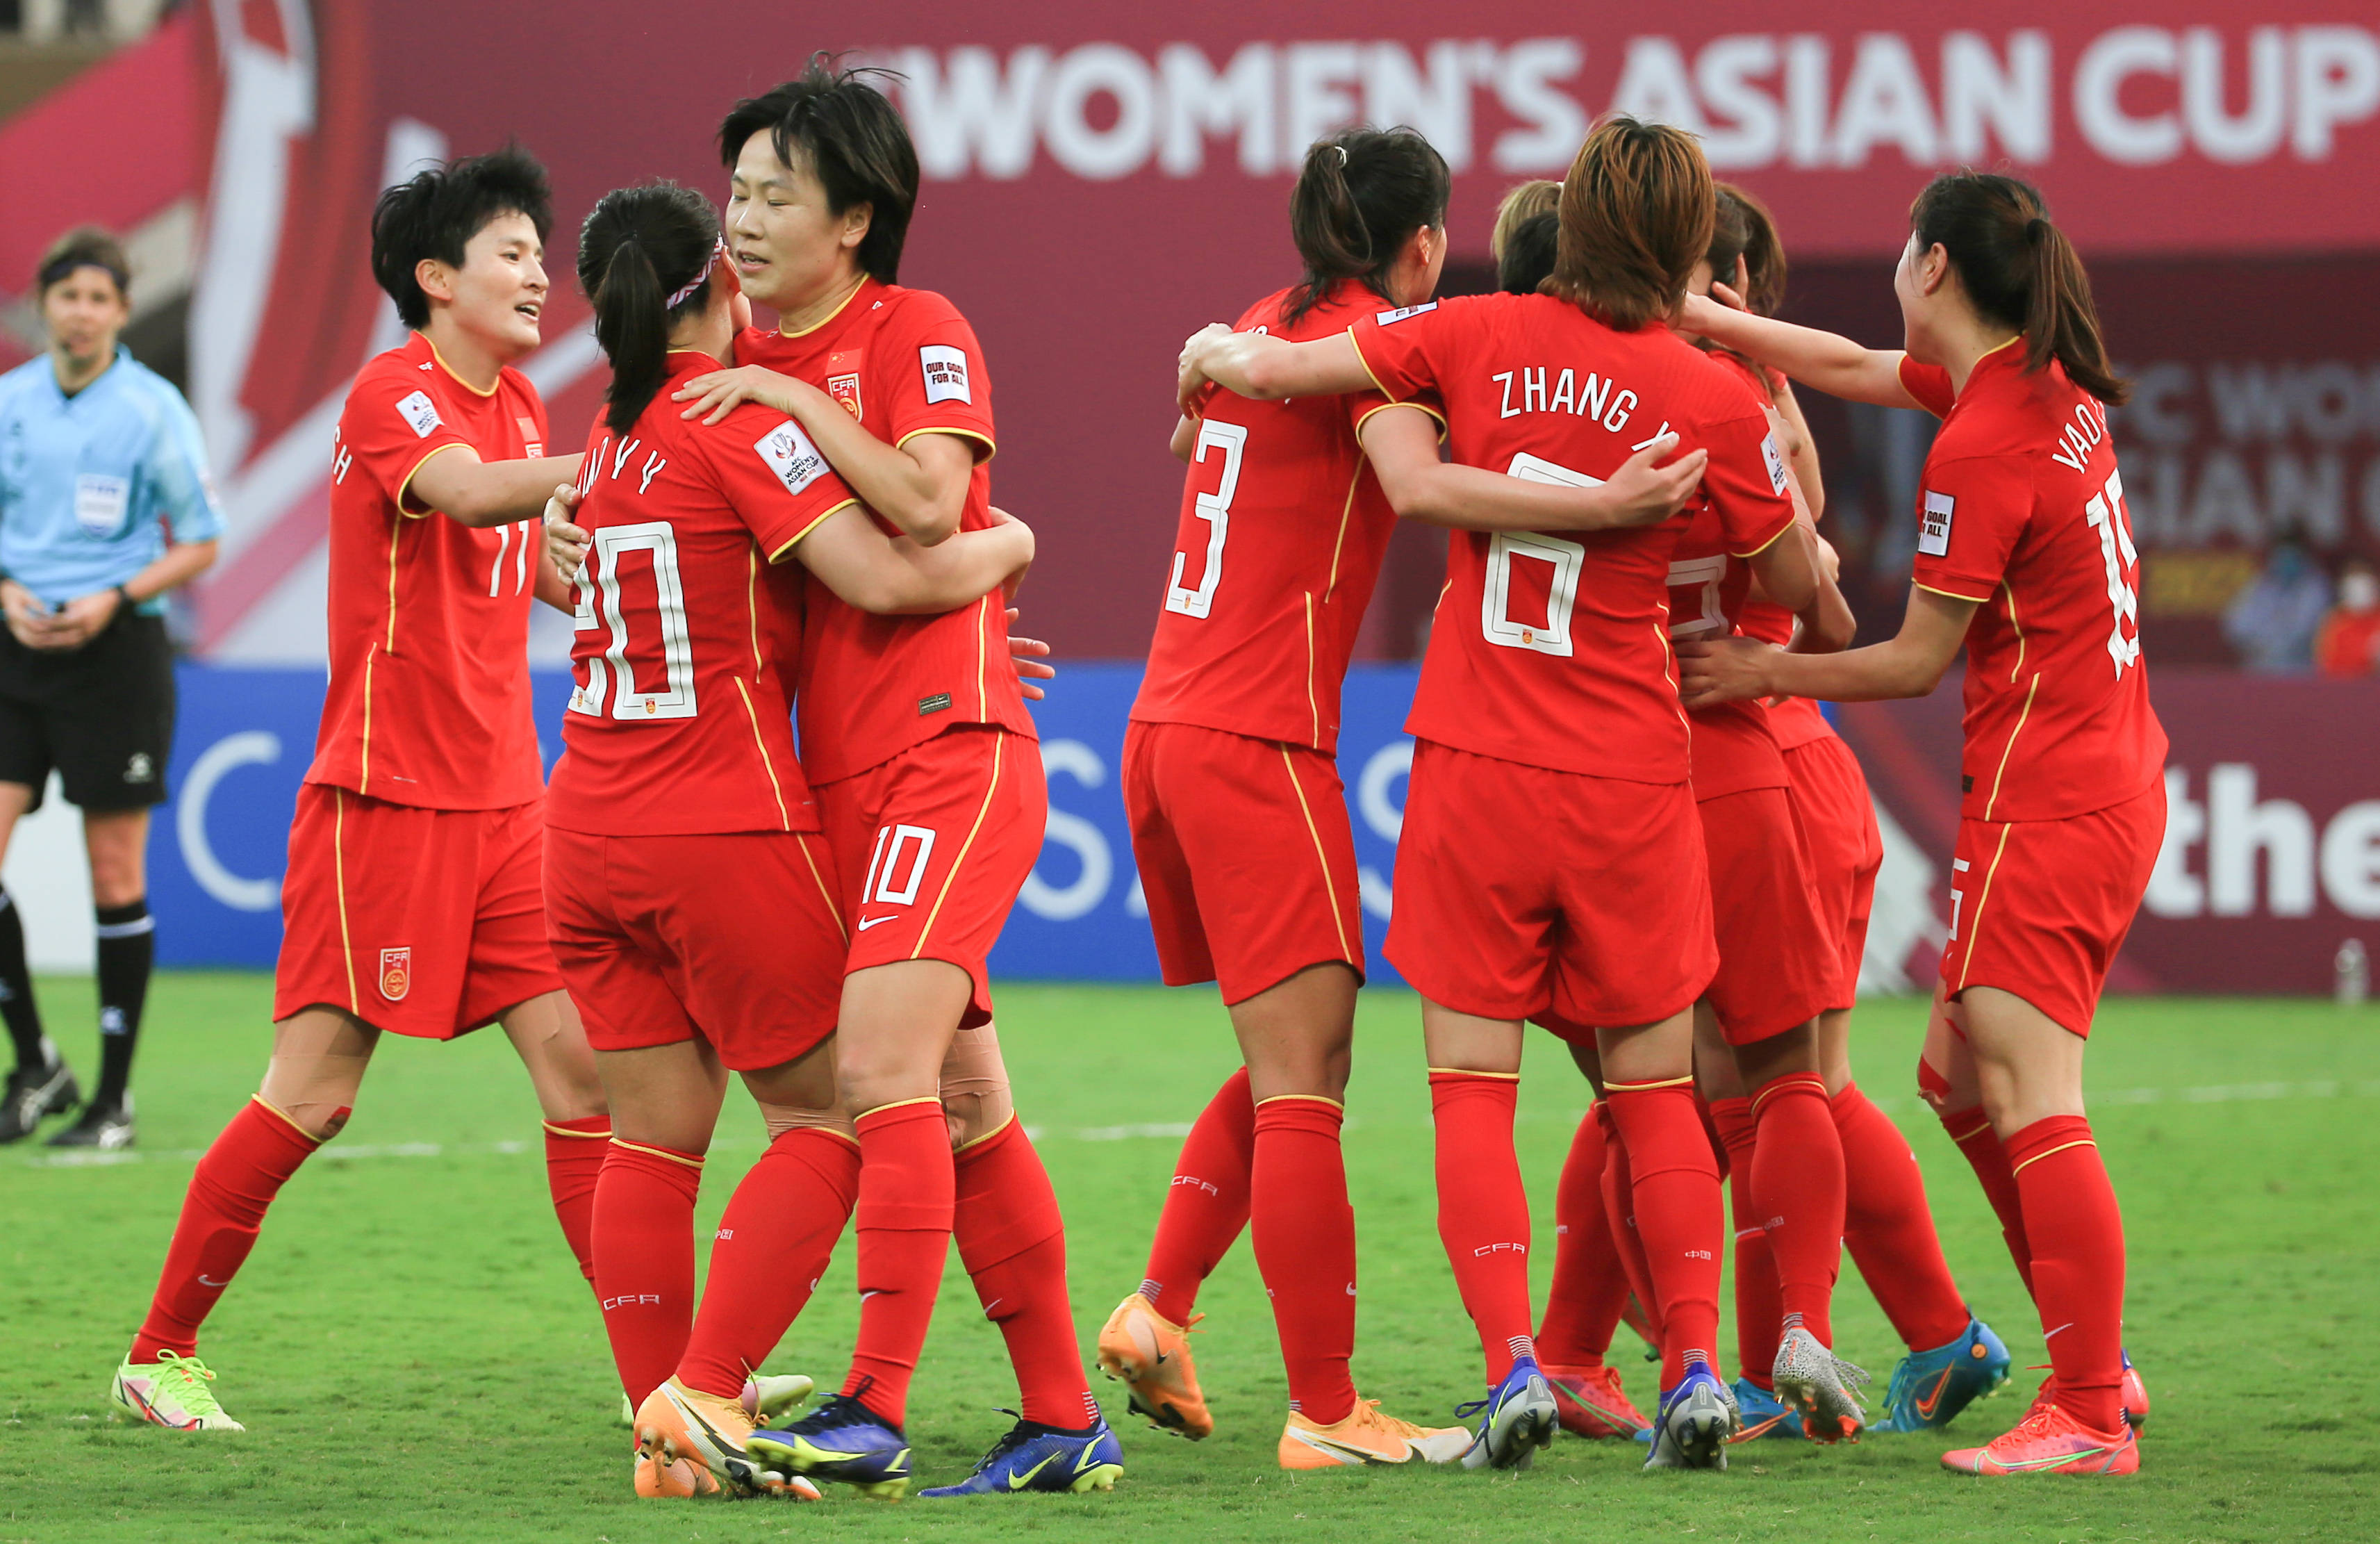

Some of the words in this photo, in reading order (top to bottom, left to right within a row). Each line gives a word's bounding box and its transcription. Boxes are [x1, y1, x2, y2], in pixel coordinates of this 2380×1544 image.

[900, 36, 1591, 181] WOMEN'S
[1606, 29, 2053, 169] ASIAN
[2072, 24, 2380, 167] CUP
[925, 361, 944, 373] OUR
[832, 379, 855, 393] CFA
[932, 373, 949, 385] FOR
[952, 374, 964, 386] ALL
[1491, 366, 1639, 433] ZHANG
[2051, 403, 2101, 474] YAO
[784, 455, 815, 479] WOMEN'S
[788, 468, 807, 486] ASIAN
[1164, 418, 1248, 620] 3
[1926, 511, 1948, 526] GOAL
[1927, 524, 1942, 537] ALL
[488, 520, 530, 598] 11
[1481, 452, 1609, 657] 6
[861, 824, 936, 907] 10
[385, 952, 408, 963] CFA
[1171, 1175, 1218, 1197] CFA
[1474, 1242, 1526, 1257] CFA
[1684, 1249, 1712, 1260] 中国
[603, 1294, 660, 1311] CFA
